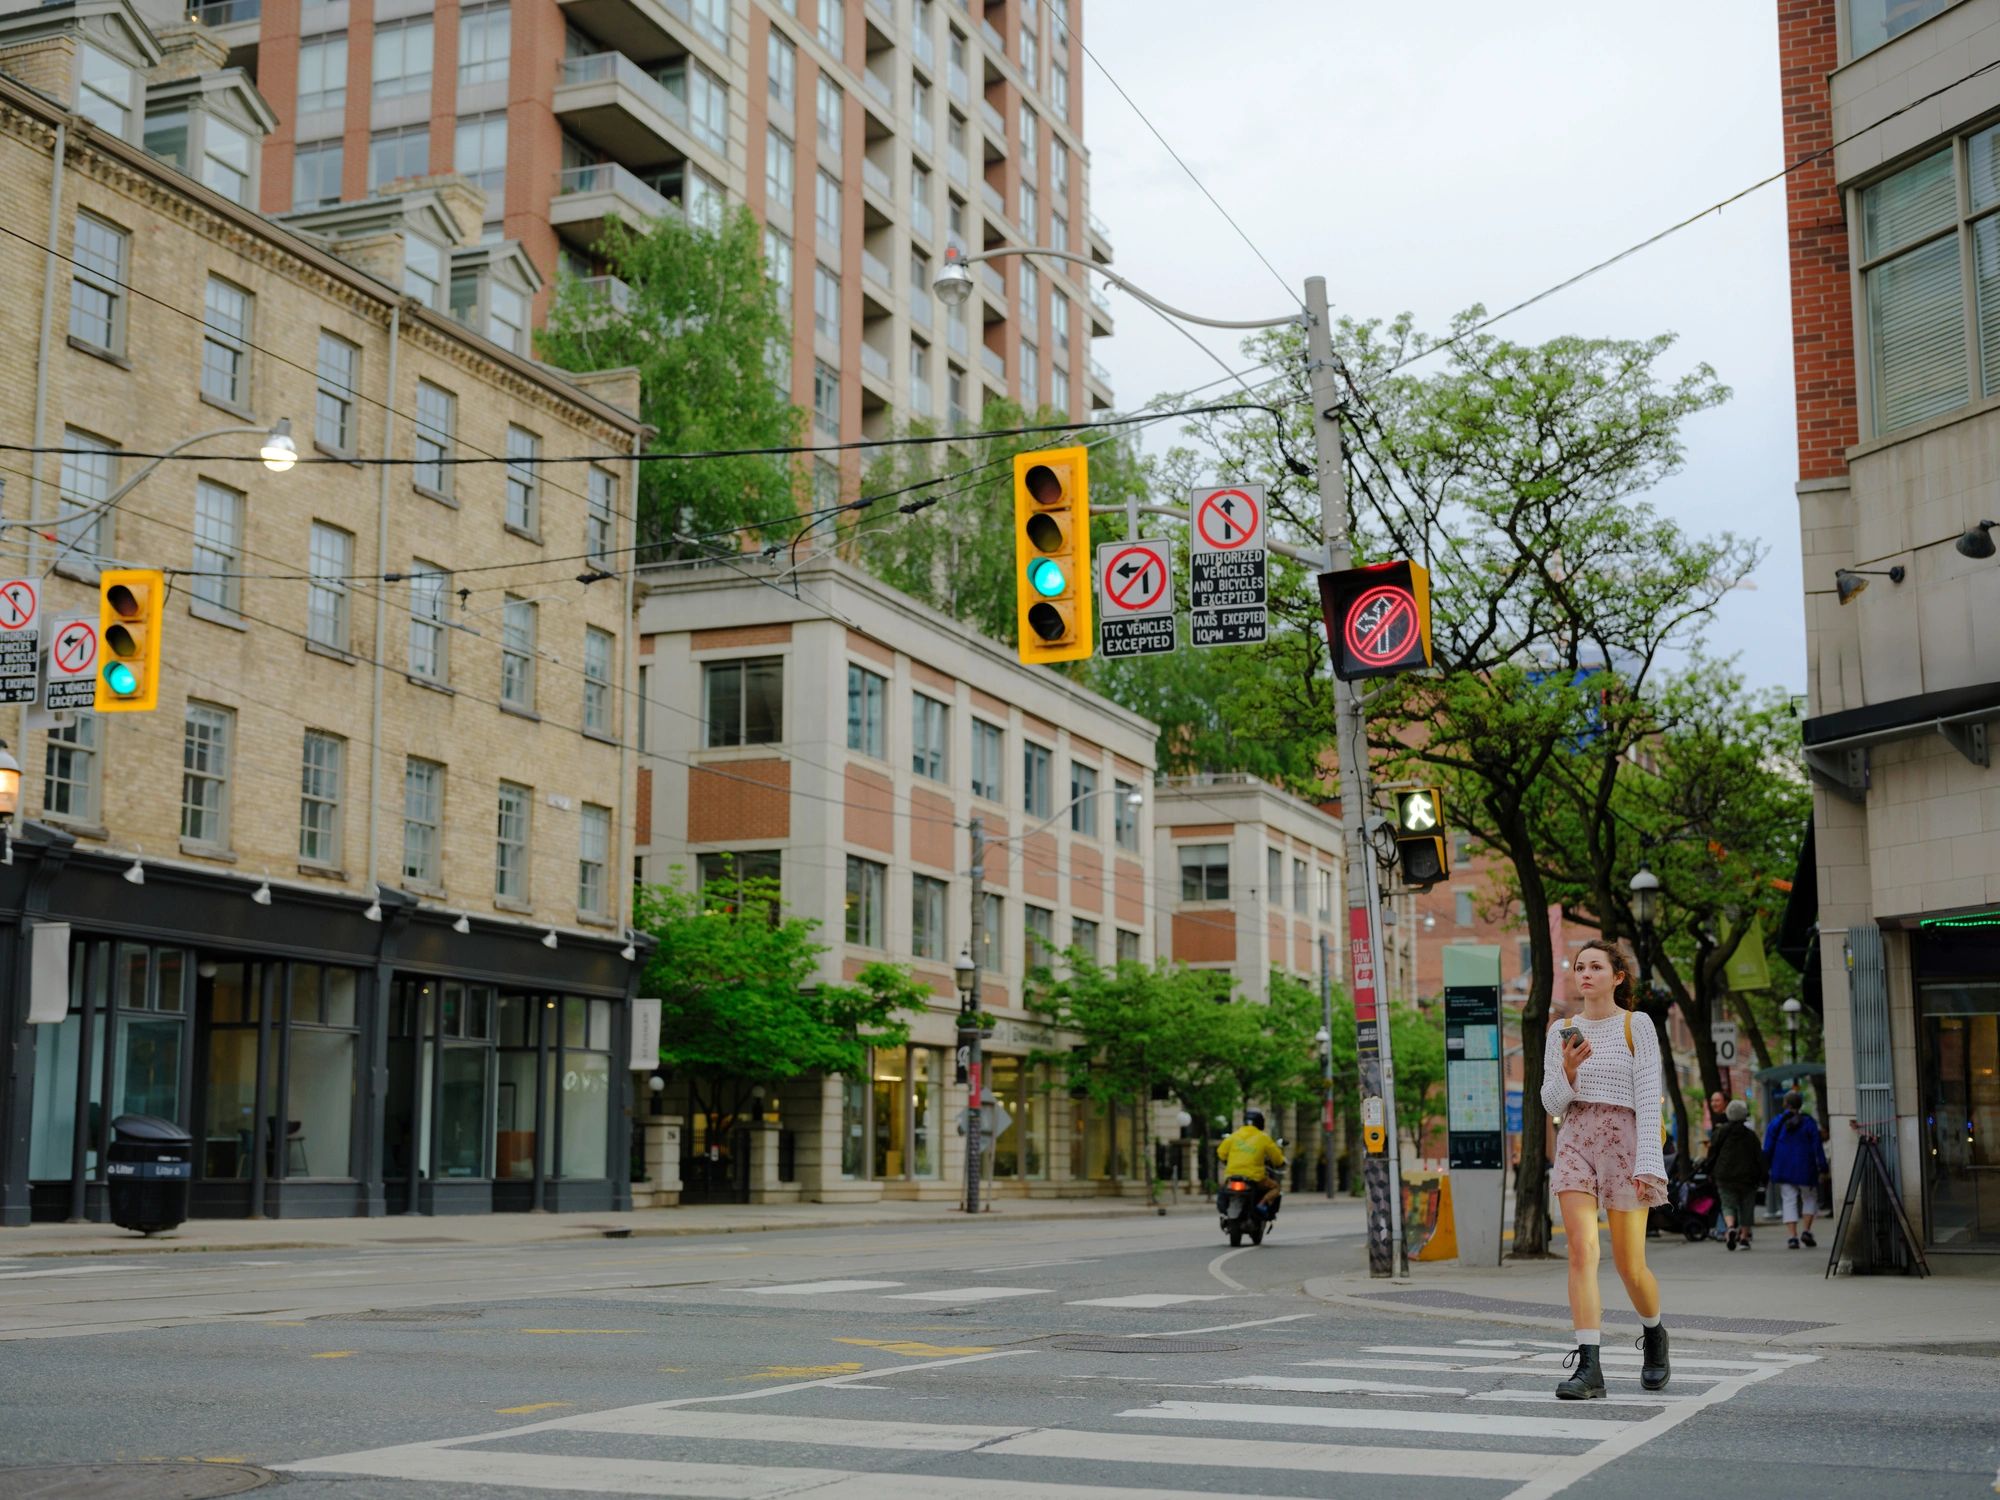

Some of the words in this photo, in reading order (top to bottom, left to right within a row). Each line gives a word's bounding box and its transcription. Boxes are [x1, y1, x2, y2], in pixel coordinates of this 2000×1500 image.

[1195, 551, 1262, 566] AUTHORIZED
[1203, 564, 1255, 579] VEHICLES
[1194, 581, 1213, 593] AND
[1219, 577, 1264, 591] BICYCLES
[1201, 591, 1256, 606] EXCEPTED
[1193, 614, 1217, 627] TAXIS
[1222, 611, 1266, 626] EXCEPTED
[1103, 625, 1123, 638] TTC
[1127, 620, 1173, 636] VEHICLES
[1106, 635, 1170, 652] EXCEPTED
[49, 693, 94, 708] EXCEPTED
